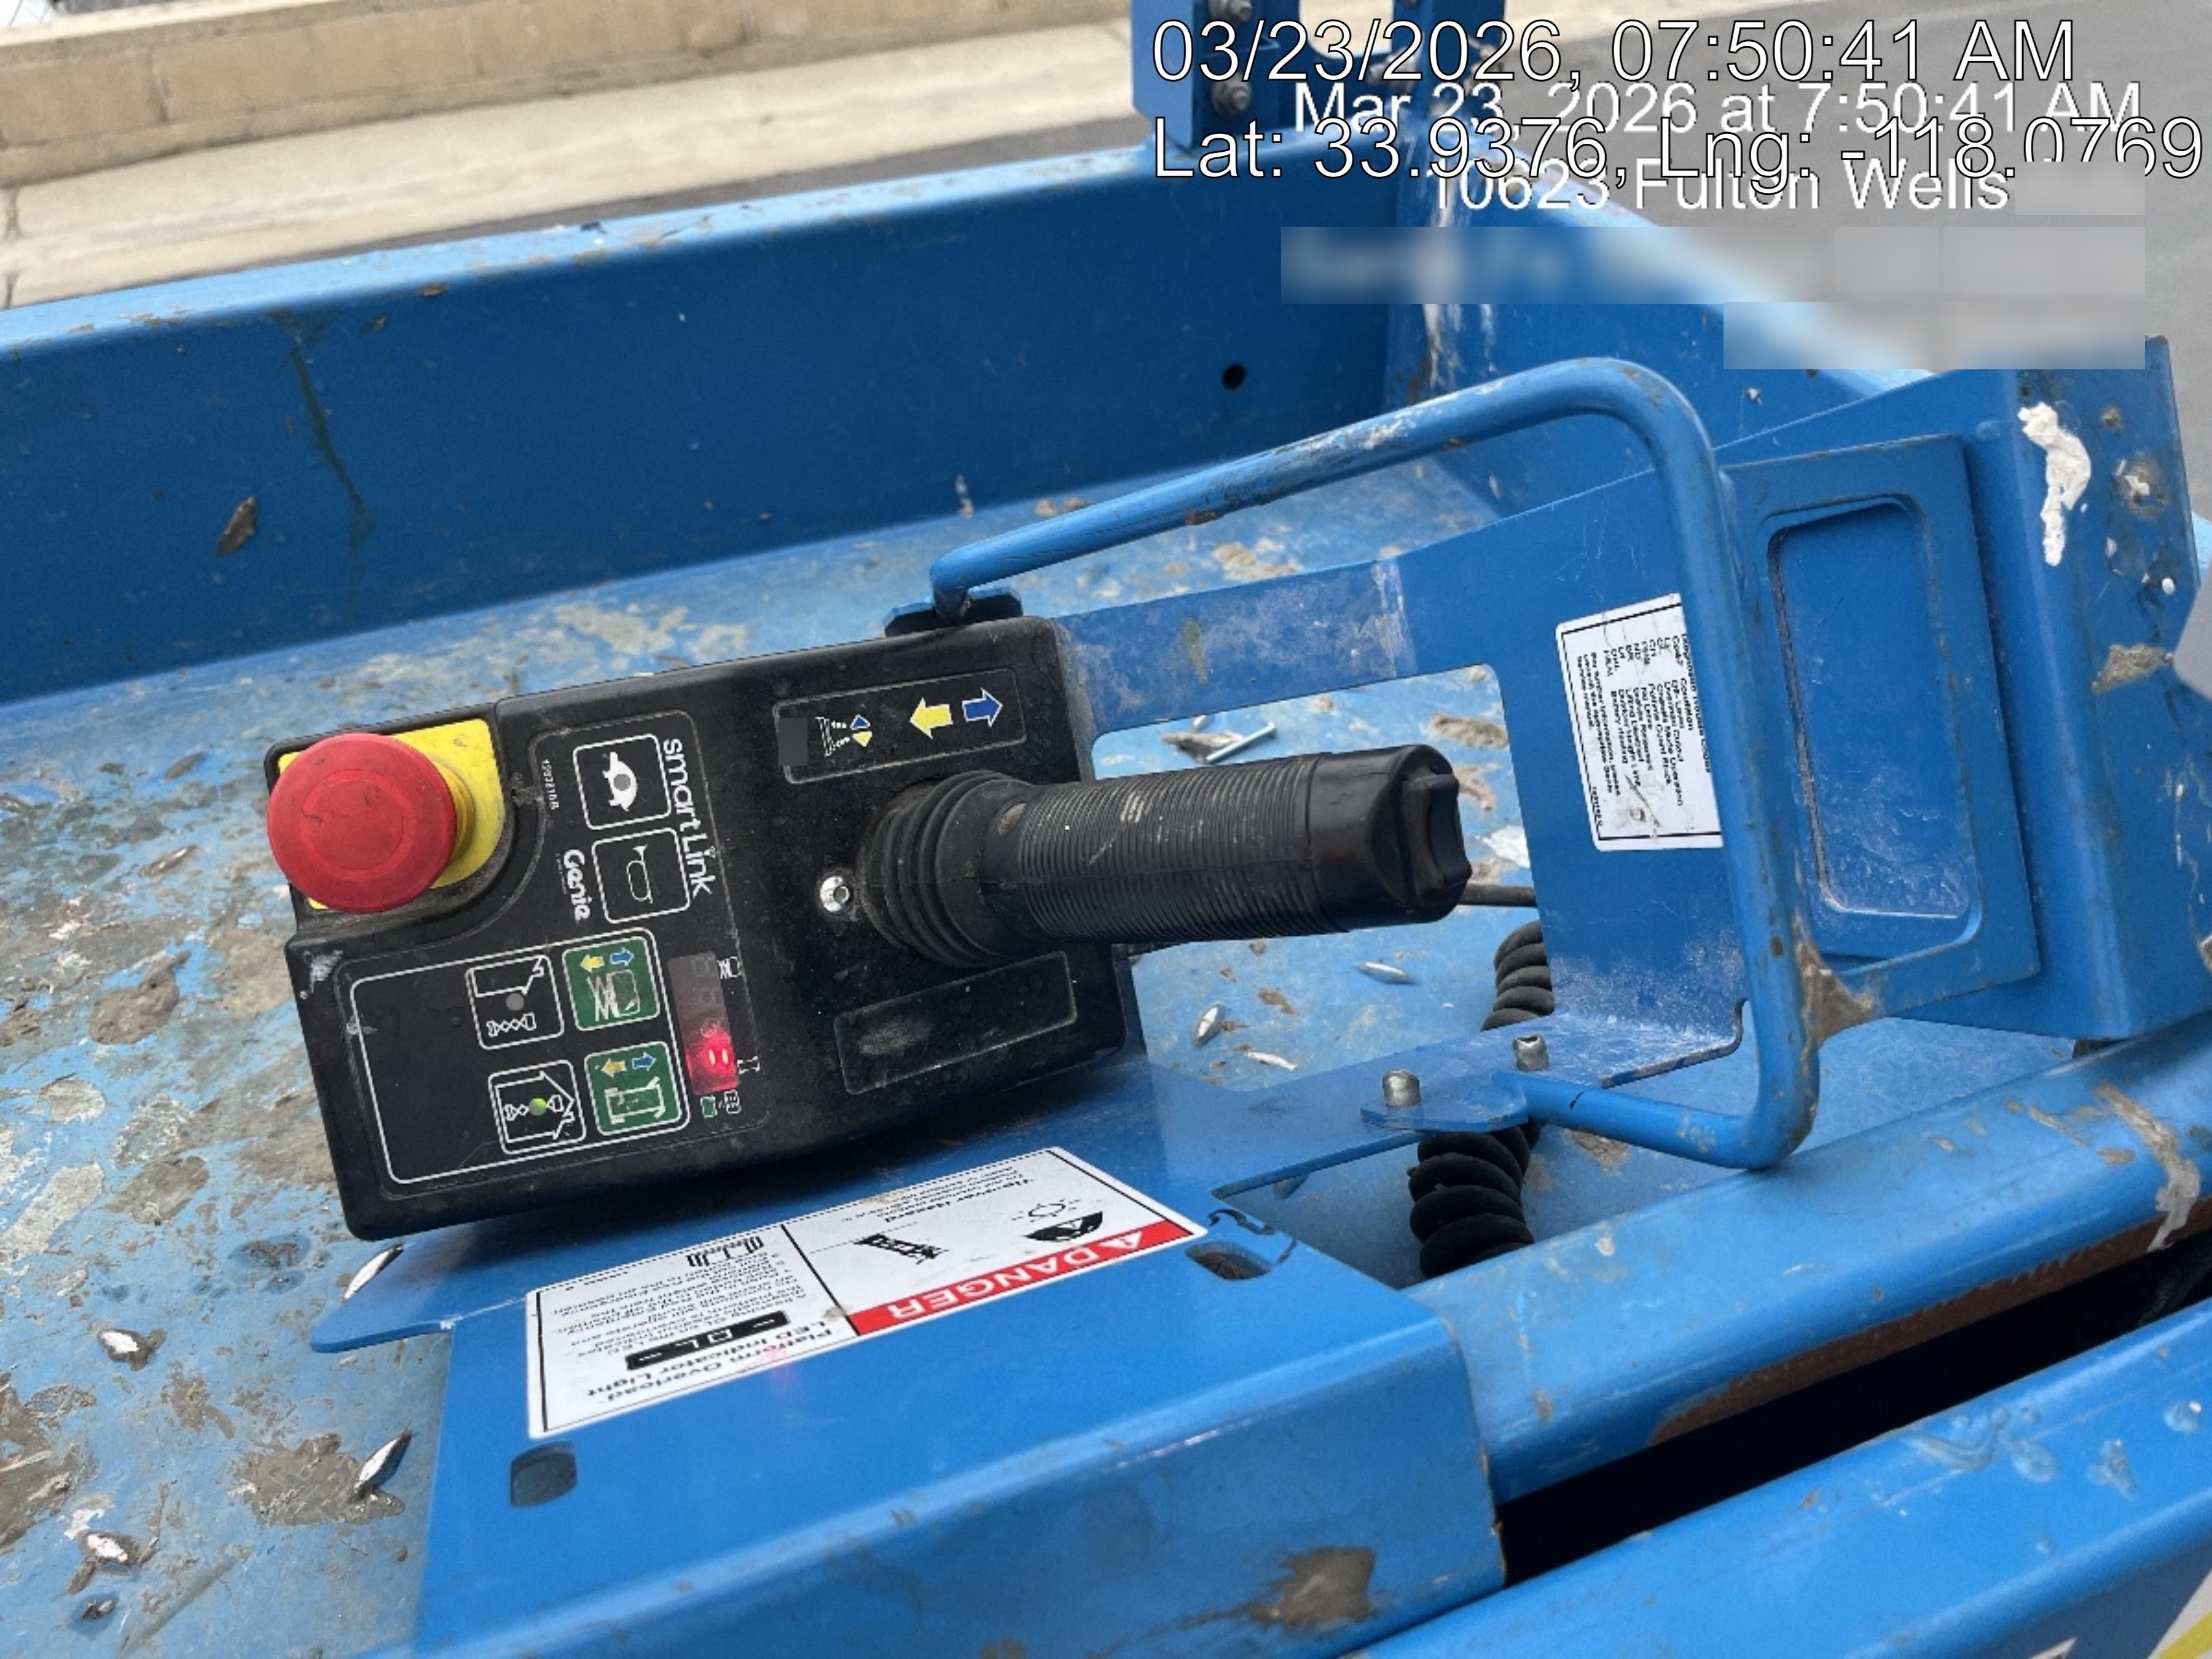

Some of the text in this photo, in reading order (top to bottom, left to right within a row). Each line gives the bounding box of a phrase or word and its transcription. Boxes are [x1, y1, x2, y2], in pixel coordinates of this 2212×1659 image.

[562, 848, 592, 922] Genie
[888, 1248, 1098, 1317] DANGER
[589, 1322, 825, 1396] LED Indicator Light
[608, 1329, 831, 1401] Platform Overload
